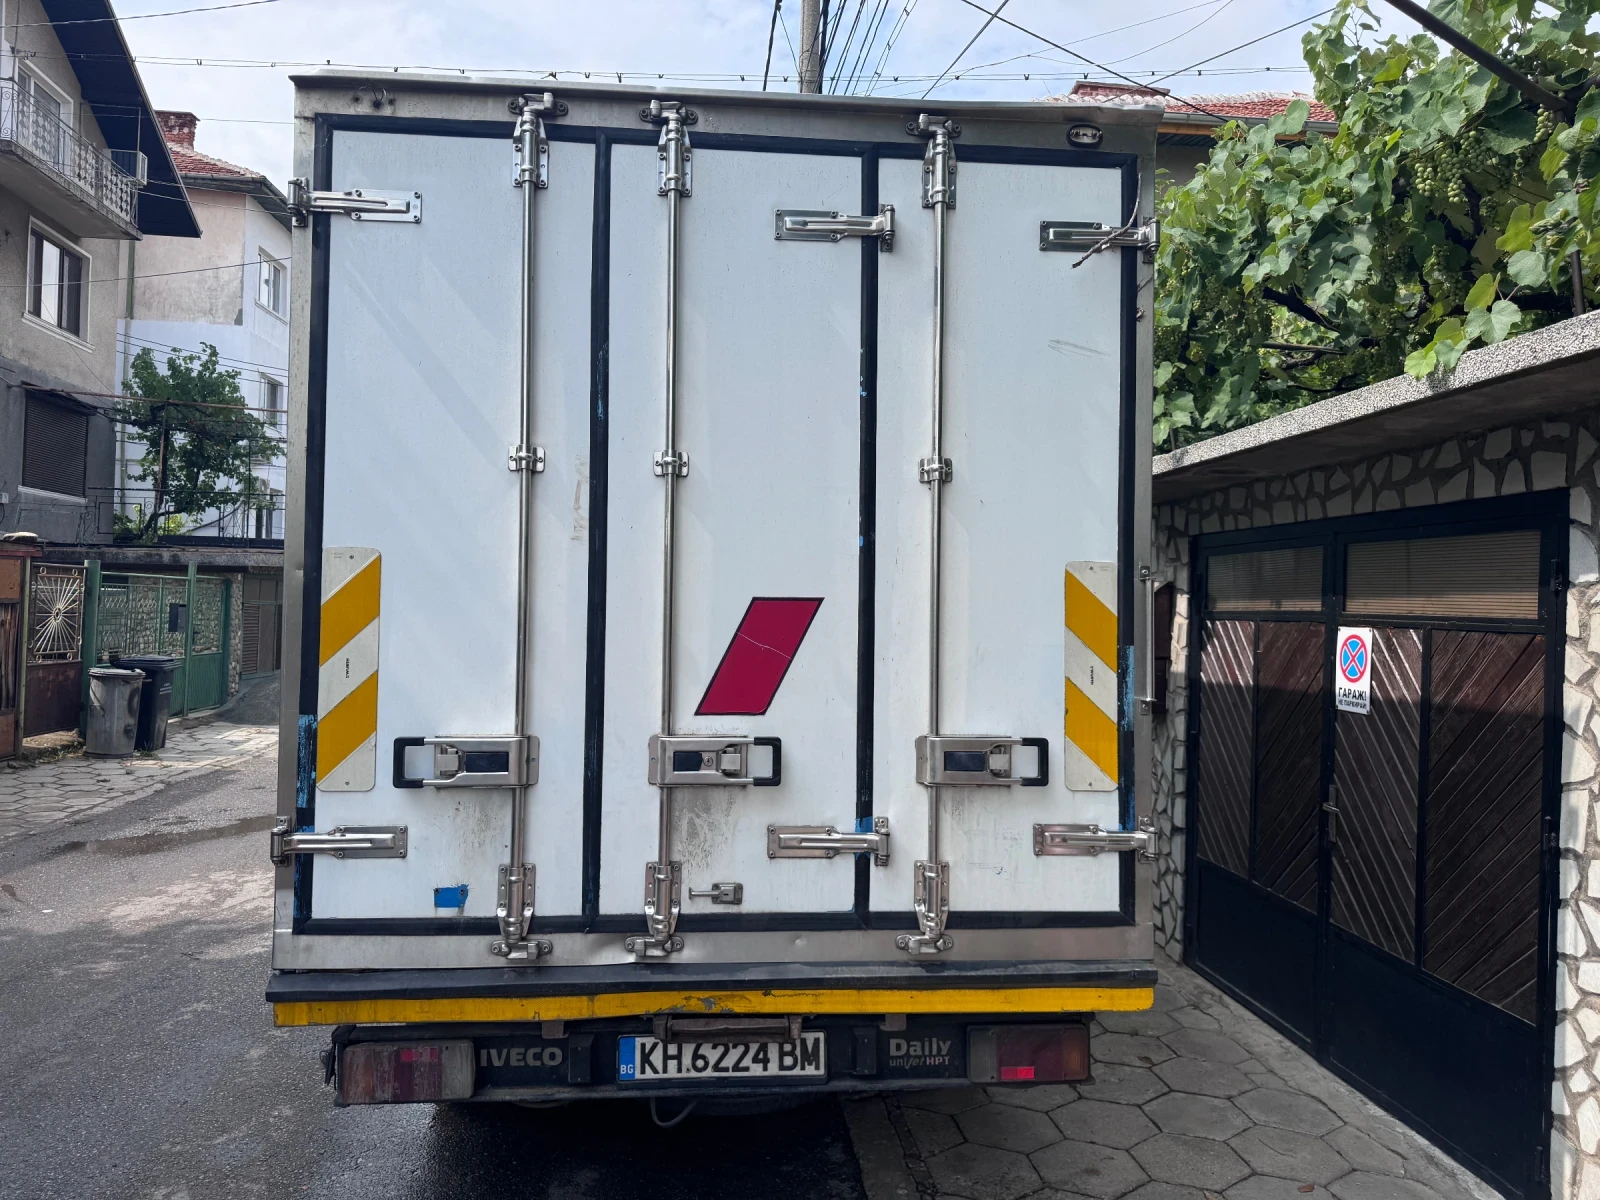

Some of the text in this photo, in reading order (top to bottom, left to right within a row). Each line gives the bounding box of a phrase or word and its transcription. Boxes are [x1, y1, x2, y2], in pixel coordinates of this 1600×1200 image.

[1338, 687, 1366, 701] ГАРАЖ!
[889, 1037, 952, 1056] Daily
[480, 1047, 563, 1067] IVECO
[691, 1042, 770, 1073] 6224
[926, 1056, 950, 1065] HPT
[620, 1064, 634, 1074] BG
